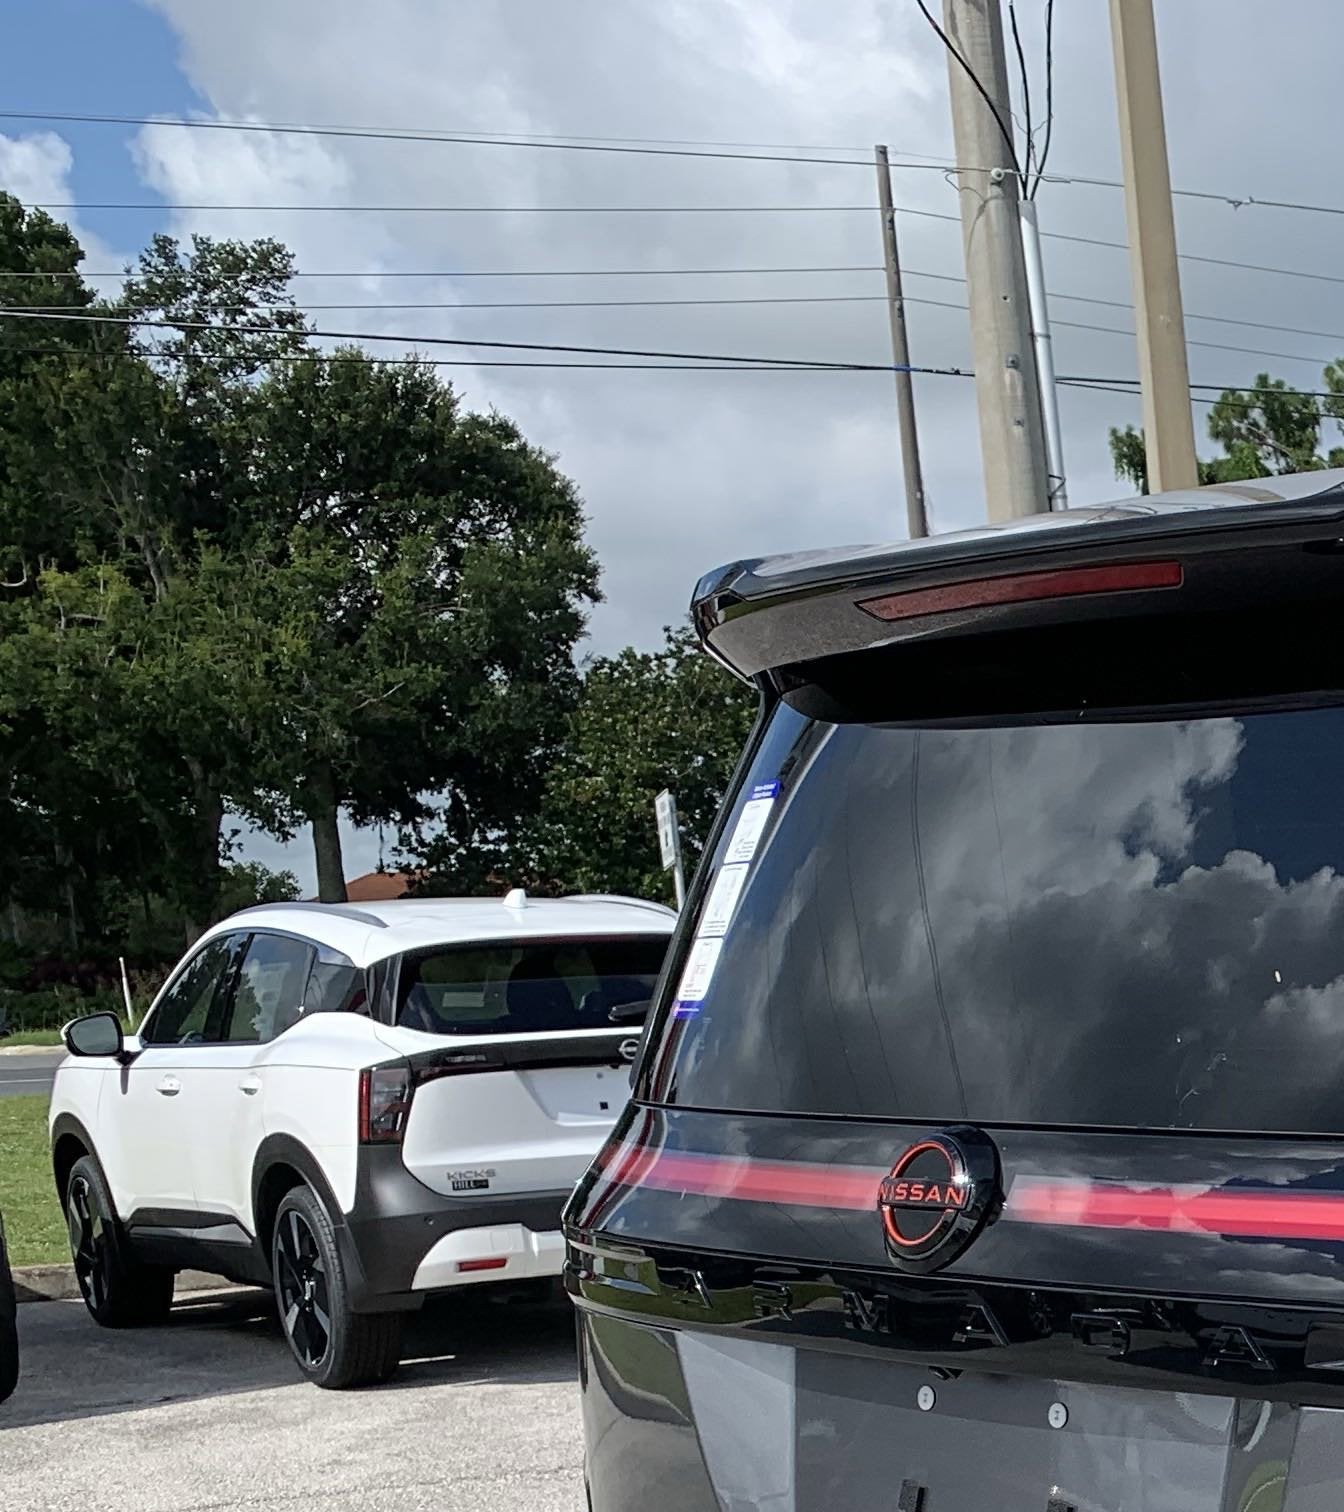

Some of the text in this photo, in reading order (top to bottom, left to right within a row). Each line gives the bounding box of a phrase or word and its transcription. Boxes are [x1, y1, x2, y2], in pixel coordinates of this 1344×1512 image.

[446, 1168, 496, 1180] KICKS
[880, 1182, 965, 1205] NISSAN
[672, 1270, 1276, 1372] ARMADA
